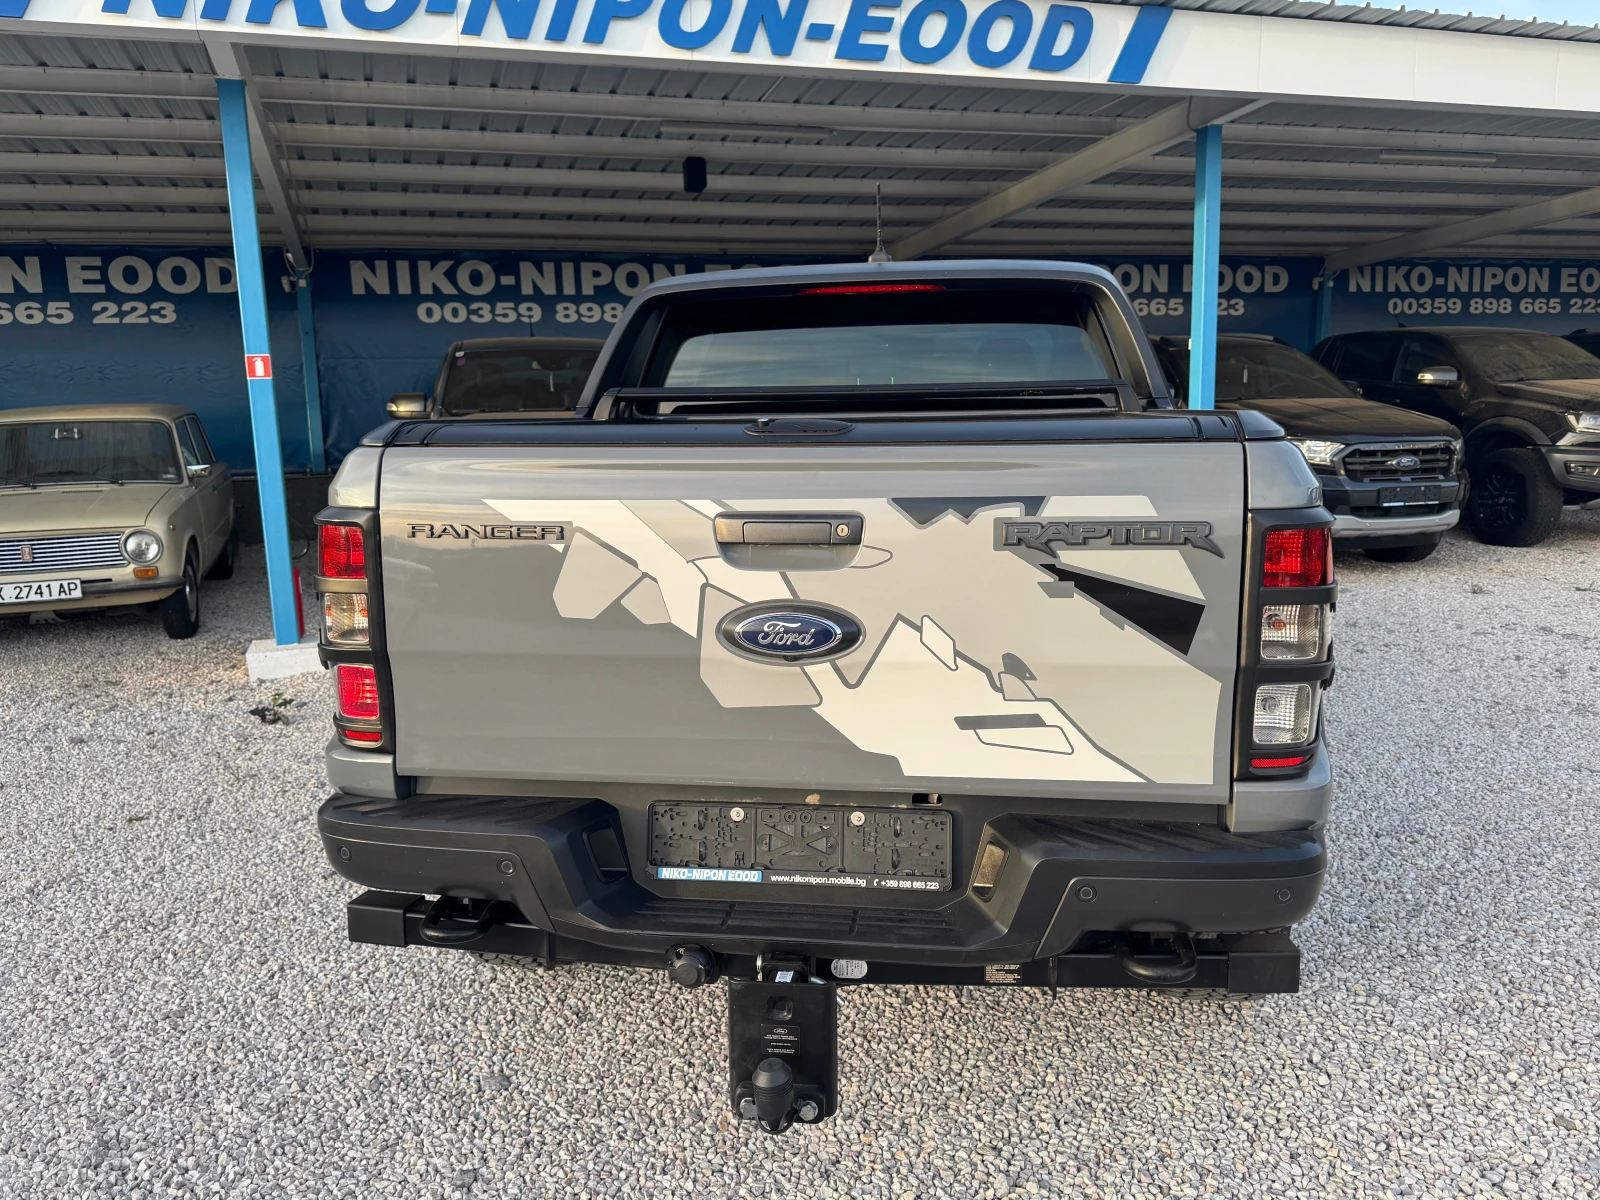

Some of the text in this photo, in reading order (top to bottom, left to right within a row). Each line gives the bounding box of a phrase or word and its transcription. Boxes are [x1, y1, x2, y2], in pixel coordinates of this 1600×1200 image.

[101, 0, 1094, 72] -NIPON-EOOD
[65, 256, 238, 294] EOOD
[1349, 265, 1549, 293] NIKO-NIPON
[92, 301, 177, 324] 223
[417, 302, 625, 323] 00359 898
[1388, 298, 1462, 314] 00359
[1469, 298, 1512, 314] 898
[1519, 298, 1561, 314] 665
[406, 523, 565, 541] RANGER
[1002, 521, 1225, 559] RAPTOR
[13, 583, 53, 600] 2741
[58, 582, 78, 597] AP
[758, 620, 816, 648] Ford
[661, 868, 759, 882] NIKO-NIPON EOOD
[770, 874, 866, 887] www.nikonipon.mobile.bg
[899, 880, 912, 888] 898
[913, 881, 925, 889] 665
[926, 881, 939, 890] 223
